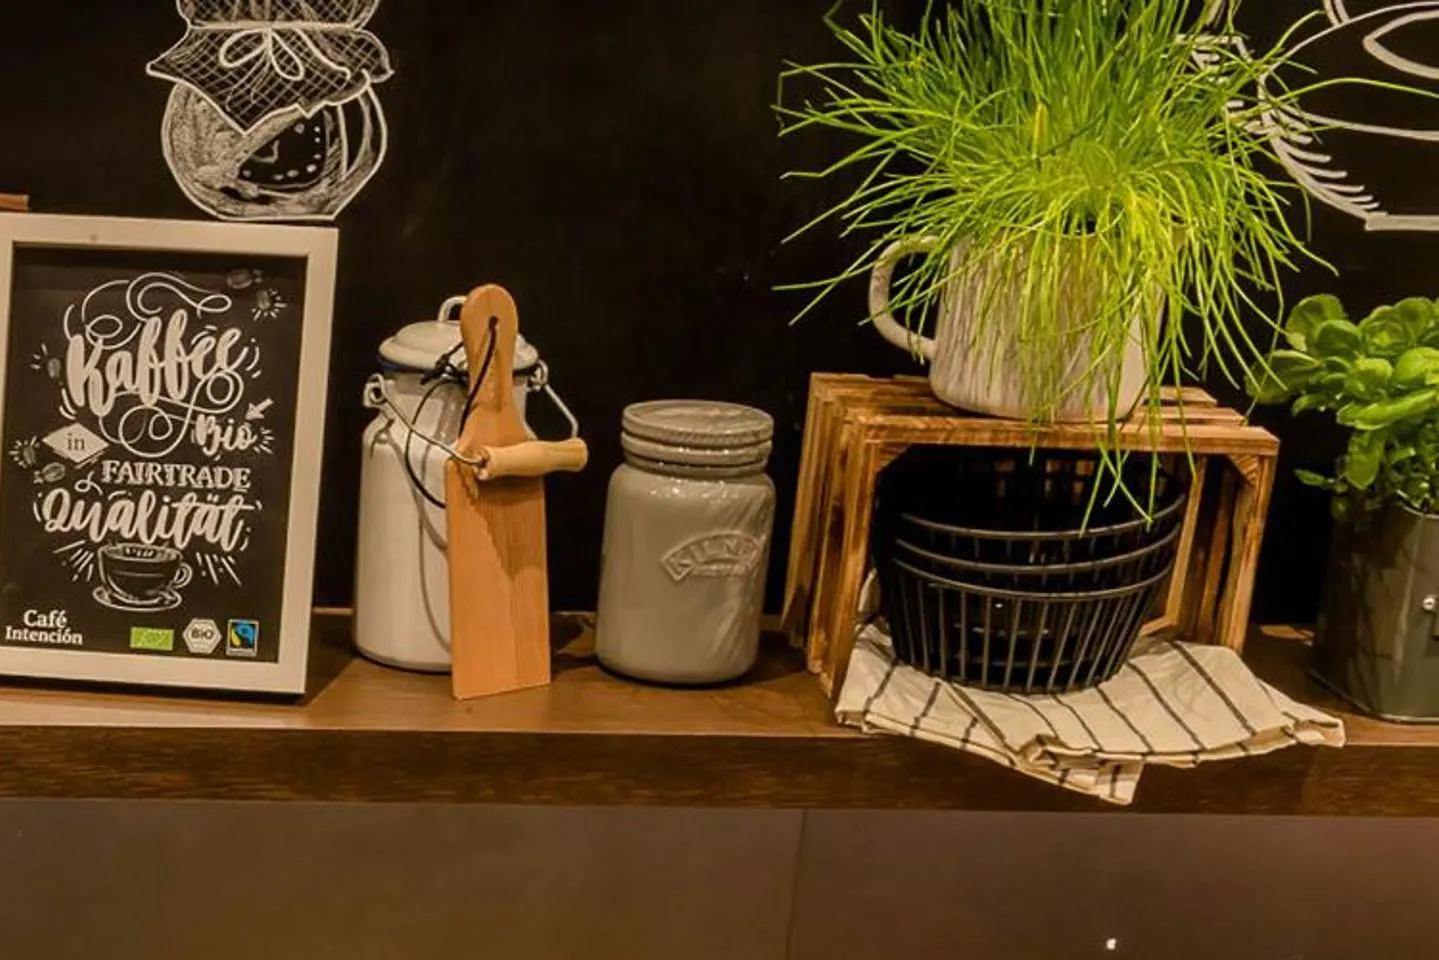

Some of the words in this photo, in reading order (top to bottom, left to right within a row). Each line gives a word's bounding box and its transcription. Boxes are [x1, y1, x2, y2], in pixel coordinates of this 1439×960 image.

[64, 305, 252, 418] Kaffee
[67, 433, 86, 451] in
[193, 413, 258, 456] Bio
[101, 459, 253, 491] FAIRTRADE
[41, 487, 256, 552] Qualität
[23, 609, 69, 628] Café
[5, 626, 84, 645] Intención
